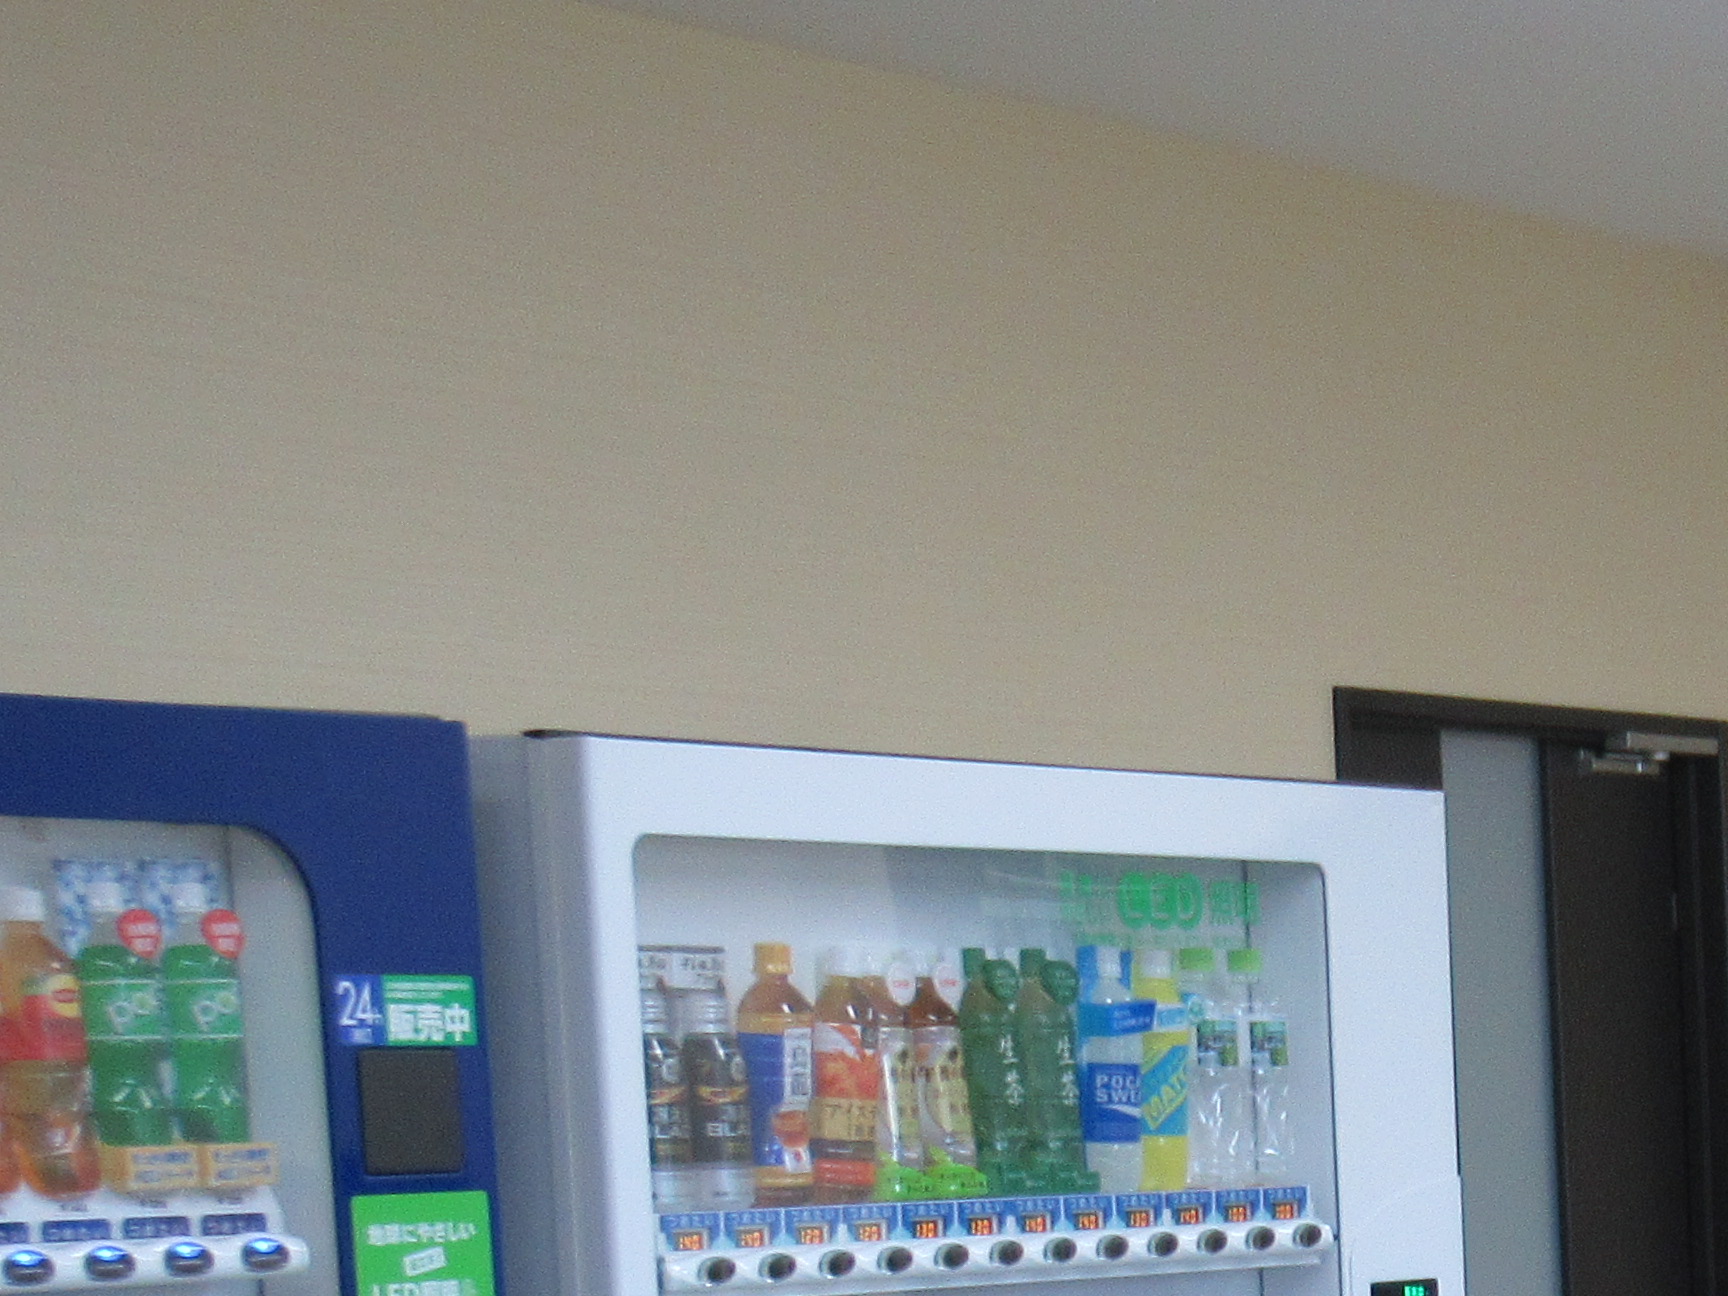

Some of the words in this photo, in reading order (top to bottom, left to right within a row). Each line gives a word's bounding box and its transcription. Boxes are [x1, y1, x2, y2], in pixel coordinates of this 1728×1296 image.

[334, 980, 383, 1027] 24
[387, 1002, 472, 1042] 販売中
